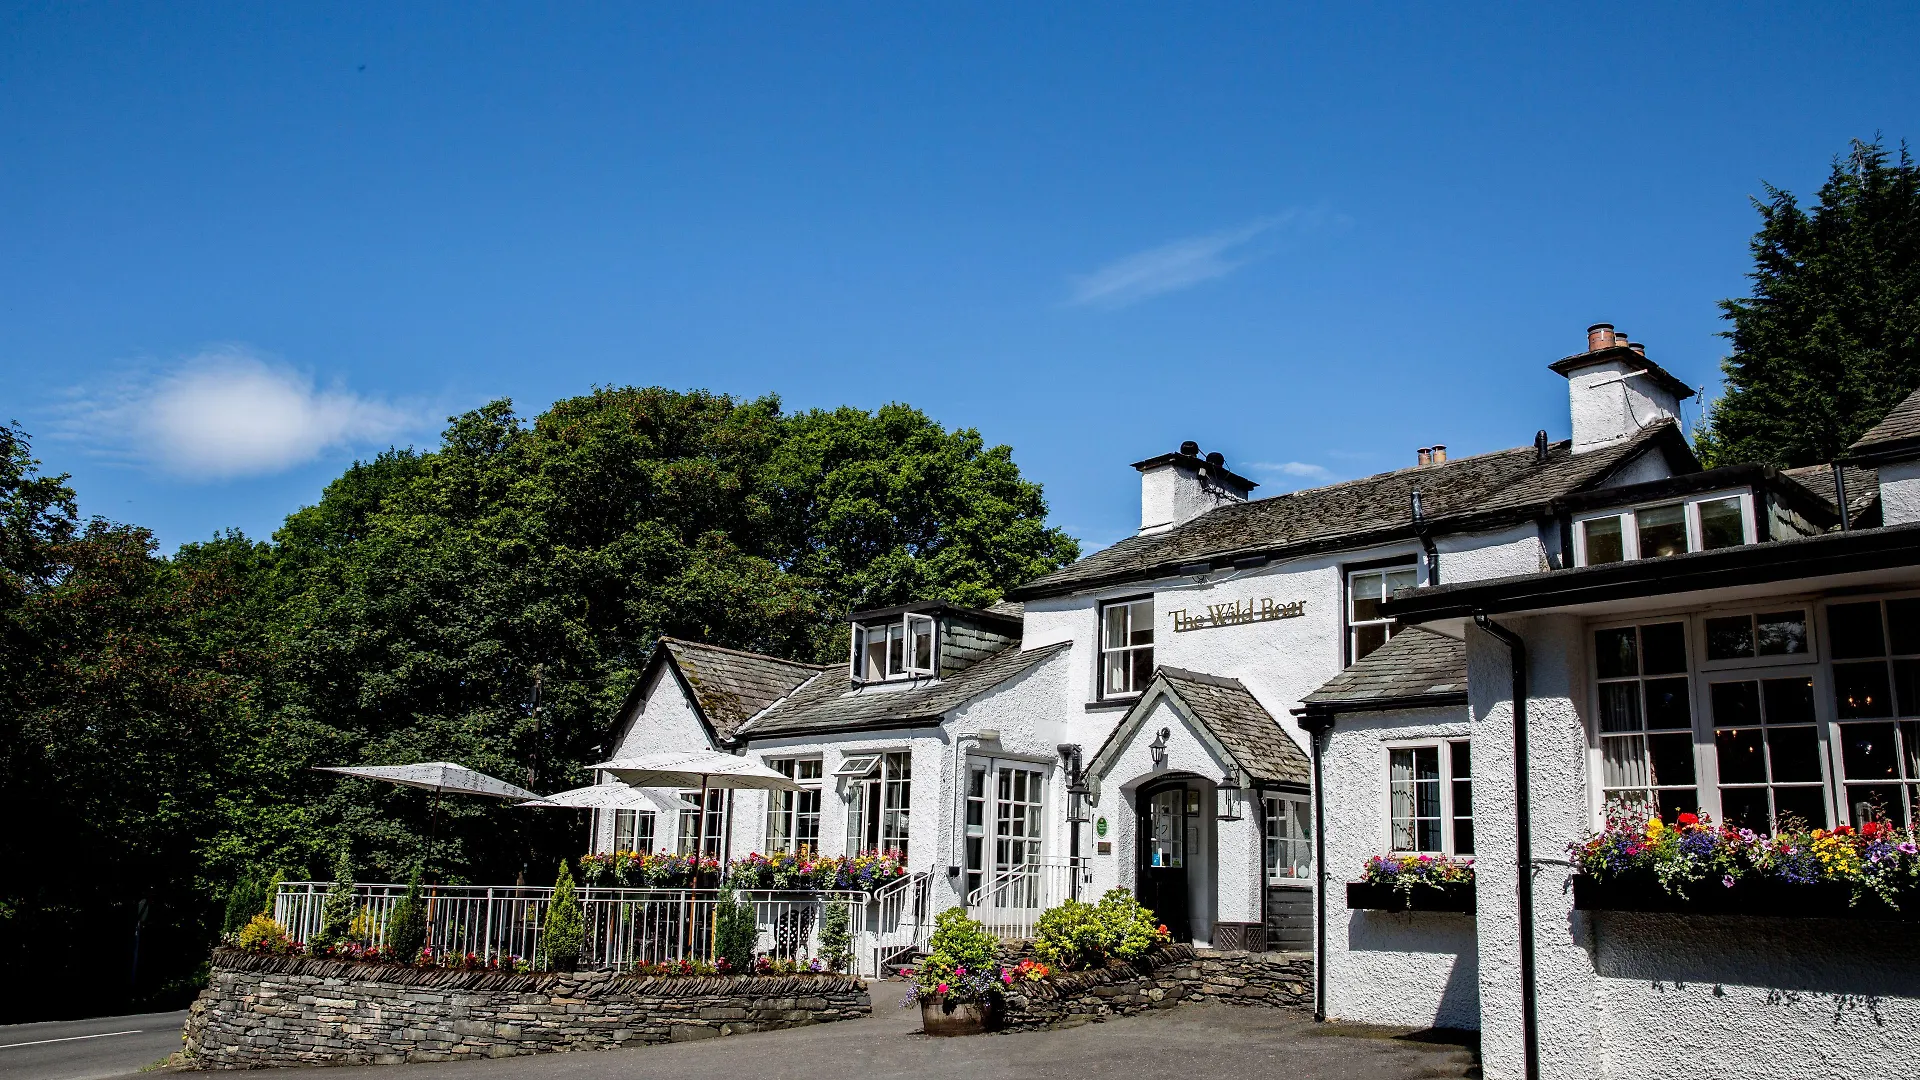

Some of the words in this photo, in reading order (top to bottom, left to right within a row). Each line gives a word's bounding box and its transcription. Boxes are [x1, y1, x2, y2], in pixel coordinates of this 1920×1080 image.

[1168, 608, 1205, 633] The
[1207, 597, 1254, 625] Wild
[1260, 597, 1307, 622] Boar
